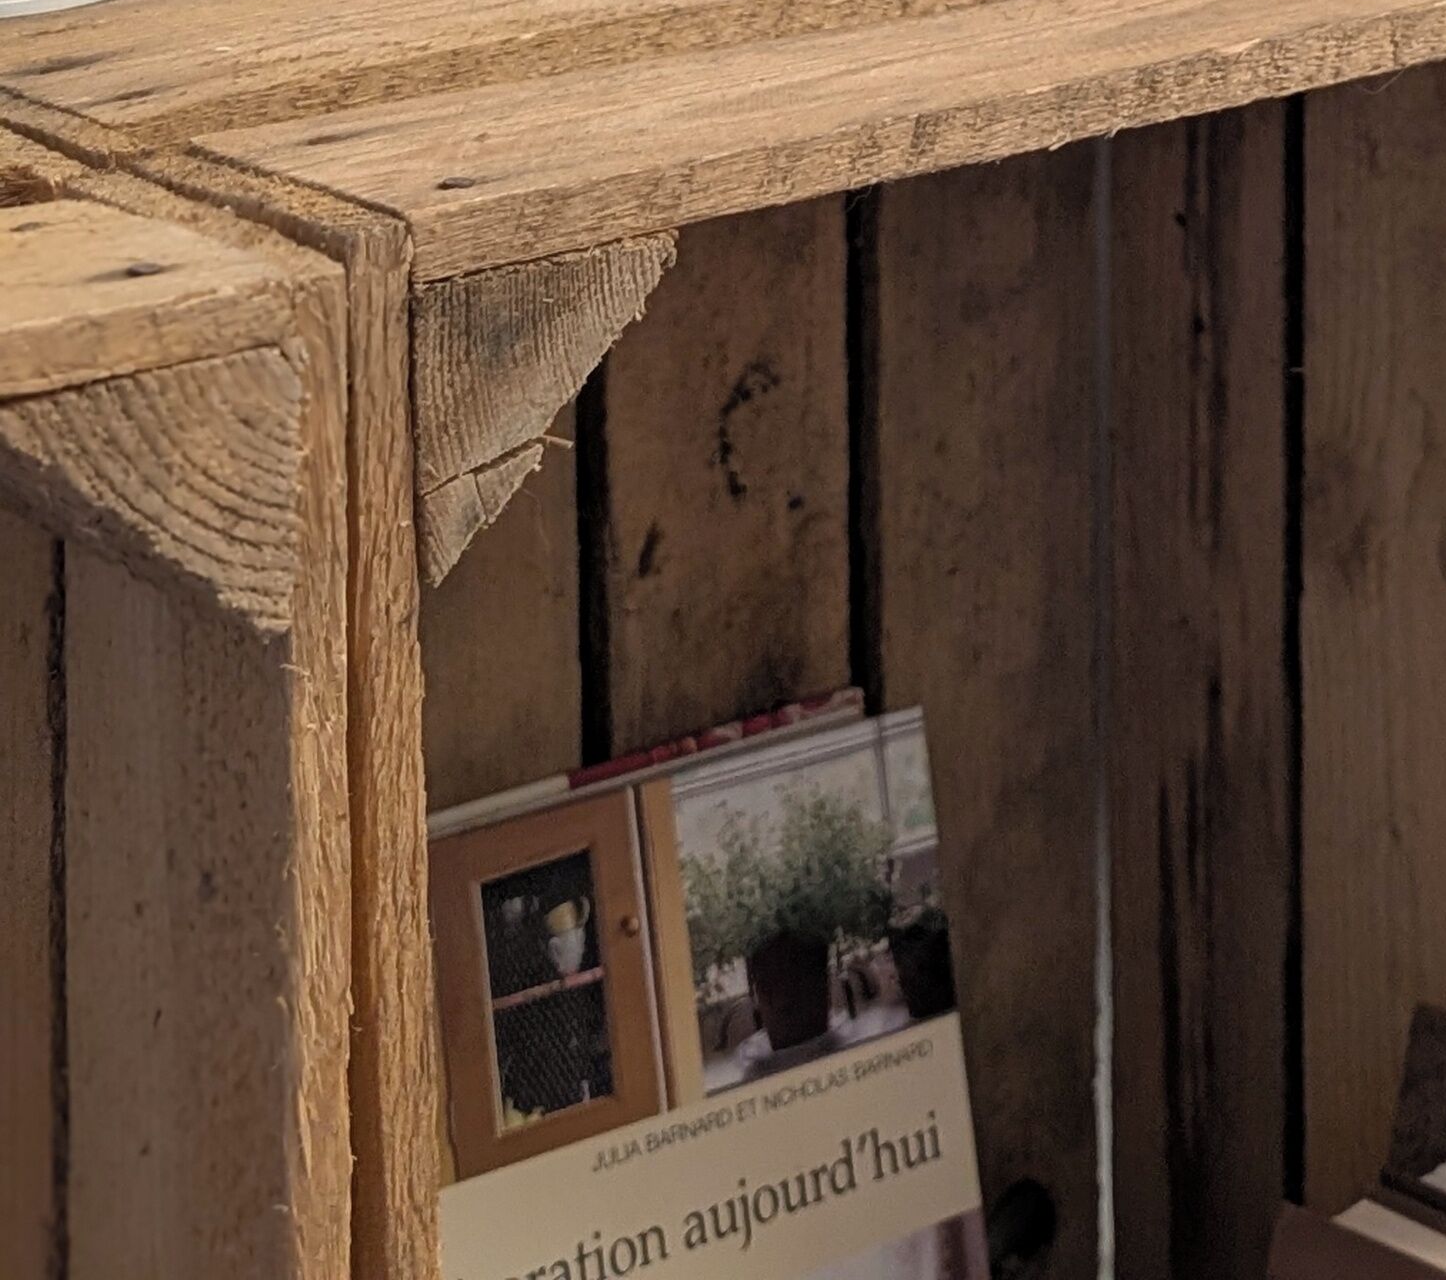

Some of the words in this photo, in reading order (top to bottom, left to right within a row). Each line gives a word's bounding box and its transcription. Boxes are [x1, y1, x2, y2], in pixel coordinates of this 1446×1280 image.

[593, 1141, 642, 1173] JULIA
[645, 1107, 734, 1153] BARNARD
[736, 1095, 758, 1124] ET
[762, 1067, 850, 1115] NICHOLAS
[854, 1040, 935, 1083] BARNARD
[682, 1109, 942, 1253] aujourd'hui
